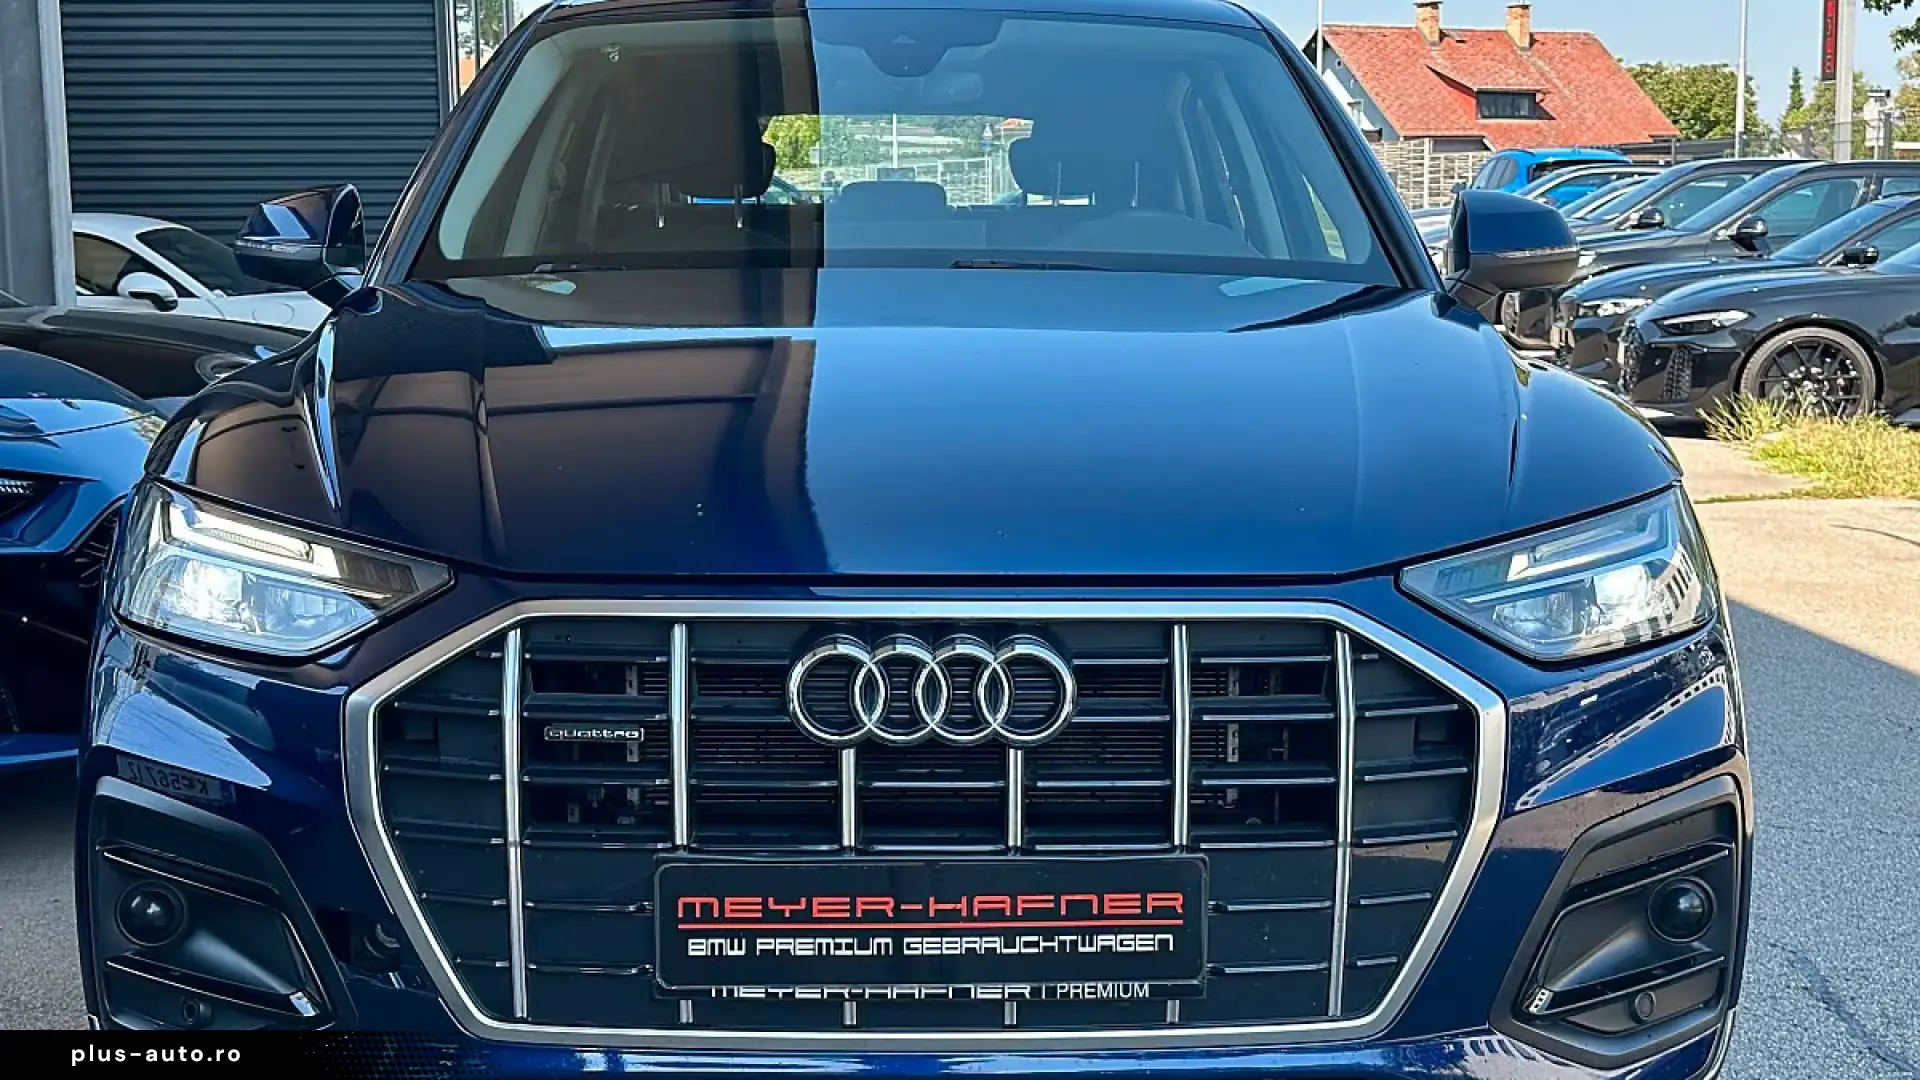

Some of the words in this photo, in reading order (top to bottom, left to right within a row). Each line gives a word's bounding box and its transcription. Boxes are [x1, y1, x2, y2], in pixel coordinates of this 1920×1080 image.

[548, 728, 640, 740] quattro
[677, 892, 1184, 918] MEYER-HAFNER
[687, 937, 747, 956] BMW
[756, 936, 894, 956] PREMIUM
[903, 933, 1174, 956] GEBRAUCHTWAGEN
[1056, 982, 1150, 999] PREMIUM
